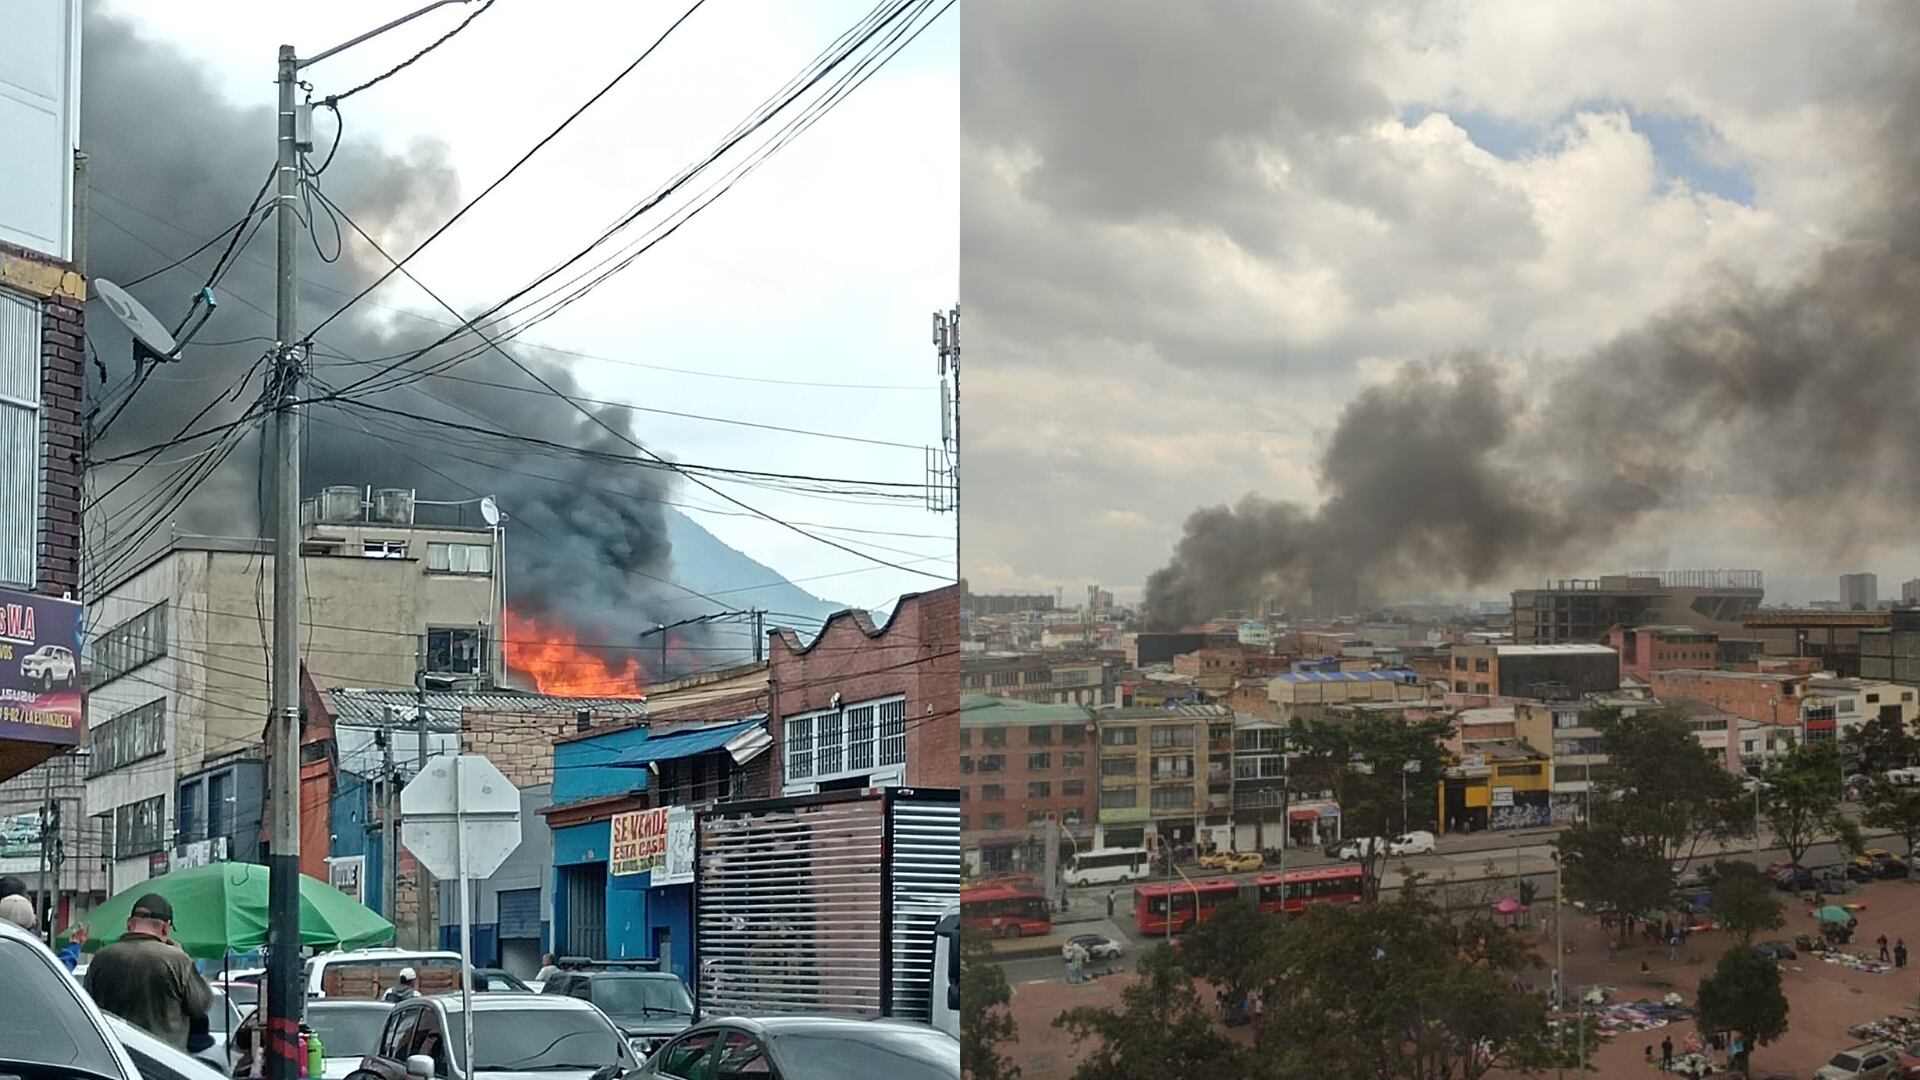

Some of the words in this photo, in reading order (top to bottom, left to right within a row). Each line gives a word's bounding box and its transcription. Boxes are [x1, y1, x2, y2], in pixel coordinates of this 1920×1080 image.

[614, 817, 628, 843] SE
[631, 809, 668, 840] VENDE
[613, 843, 637, 860] ESTA
[639, 837, 666, 857] CASA
